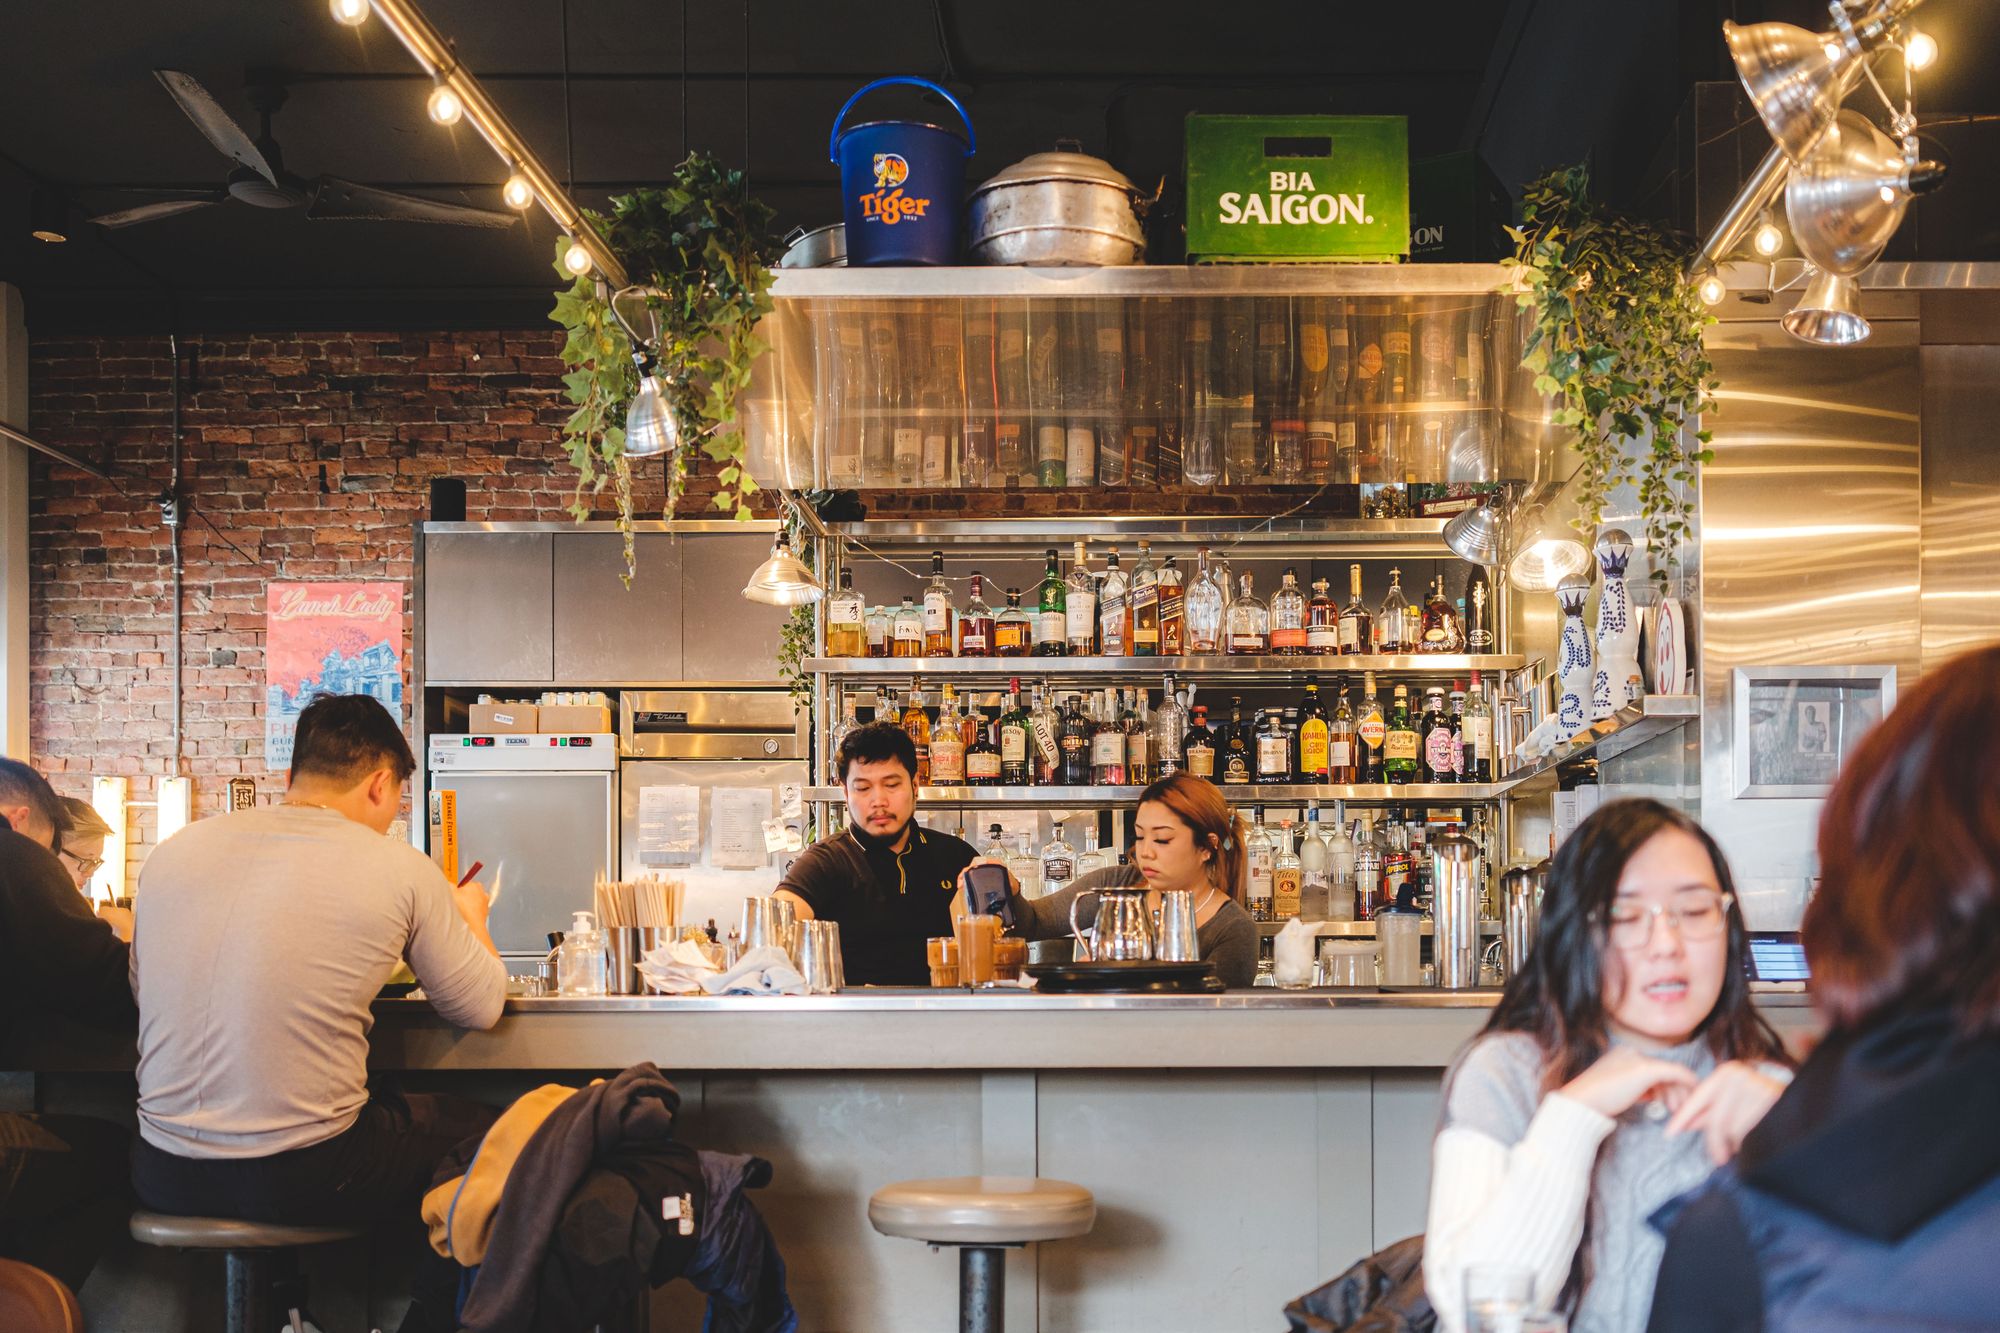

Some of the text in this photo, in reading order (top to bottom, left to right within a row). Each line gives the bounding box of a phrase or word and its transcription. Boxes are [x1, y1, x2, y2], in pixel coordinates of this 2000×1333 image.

[1270, 171, 1316, 192] BIA
[859, 188, 930, 225] Tiger
[1219, 192, 1374, 225] SAIGON.
[271, 587, 396, 623] Lunch Lady
[1035, 723, 1055, 752] LOT 40
[235, 791, 254, 804] EAST
[1387, 863, 1409, 874] APEROL
